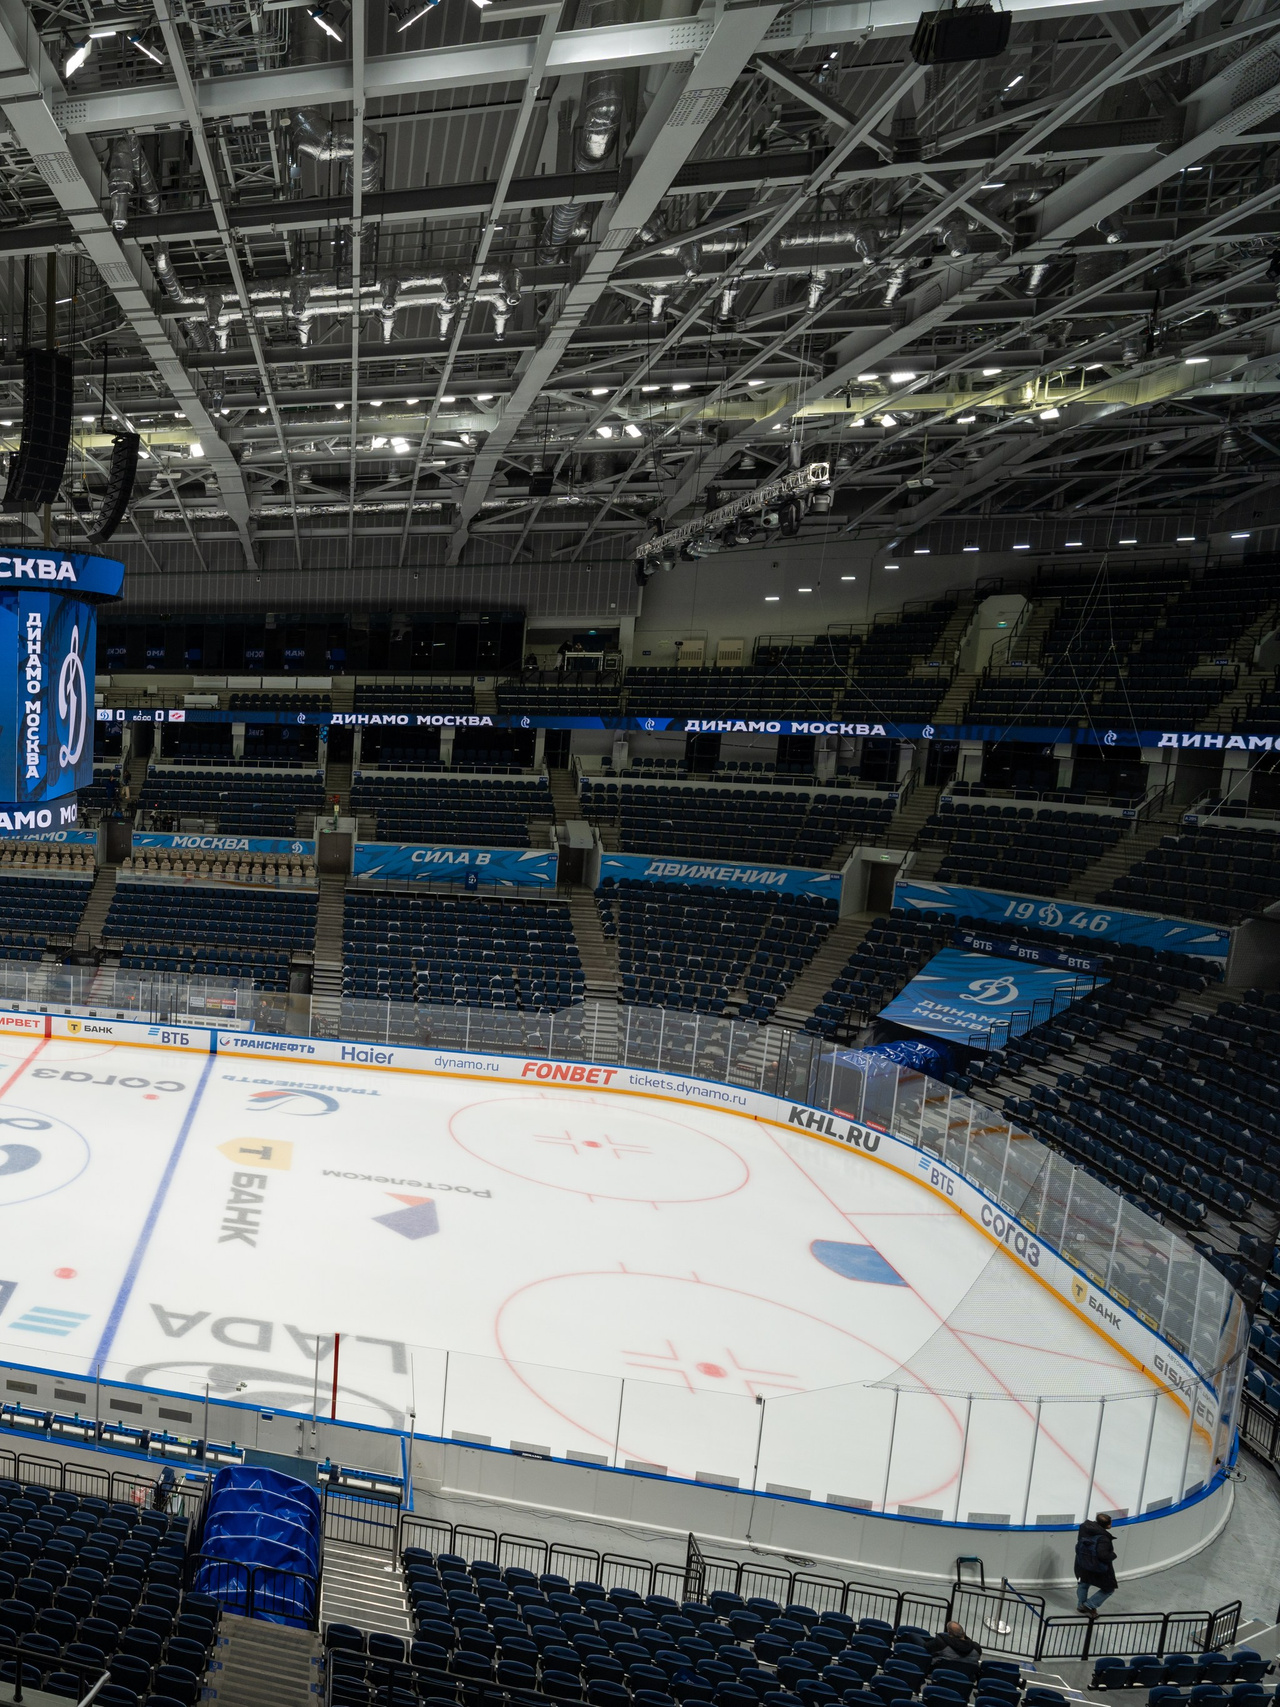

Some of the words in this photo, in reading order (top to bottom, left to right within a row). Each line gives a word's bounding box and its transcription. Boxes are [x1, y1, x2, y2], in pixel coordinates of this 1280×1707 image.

[26, 613, 43, 694] ДИНАМО
[116, 710, 125, 720] 0
[155, 710, 164, 721] 0
[330, 713, 409, 726] ДИНАМО
[416, 715, 493, 726] МОСКВА
[685, 719, 781, 732] ДИНАМО
[790, 722, 887, 736] МОСКВА
[25, 700, 41, 778] МОСКВА
[171, 837, 249, 850] МОСКВА
[411, 850, 470, 865] СИЛА
[475, 853, 492, 865] В
[644, 862, 788, 885] ДВИЖЕНИИ
[1003, 901, 1036, 919] 19
[1068, 911, 1112, 932] 46
[972, 939, 993, 951] ВТБ
[1018, 947, 1040, 960] ВТБ
[1068, 956, 1091, 970] ВТБ
[912, 1007, 996, 1034] МОСКВА
[917, 999, 1011, 1027] ДИНАМО
[84, 1024, 113, 1035] БАНК
[161, 1031, 190, 1046] ВТБ
[233, 1038, 315, 1054] ТРАНСНЕФТЬ
[341, 1046, 394, 1065] Haier
[434, 1056, 499, 1072] dynamo.ru
[521, 1062, 618, 1085] FONBET
[221, 1074, 382, 1096] ТРАНСНЕФТЬ
[629, 1074, 747, 1106] tickets.dynamo.ru
[788, 1106, 881, 1153] KHL.RU
[322, 1169, 492, 1199] Ростелеком
[930, 1167, 955, 1197] ВТБ
[217, 1171, 268, 1248] БАНК
[1088, 1295, 1122, 1330] БАНК
[148, 1302, 409, 1375] LADA
[1154, 1354, 1214, 1428] GISLAED
